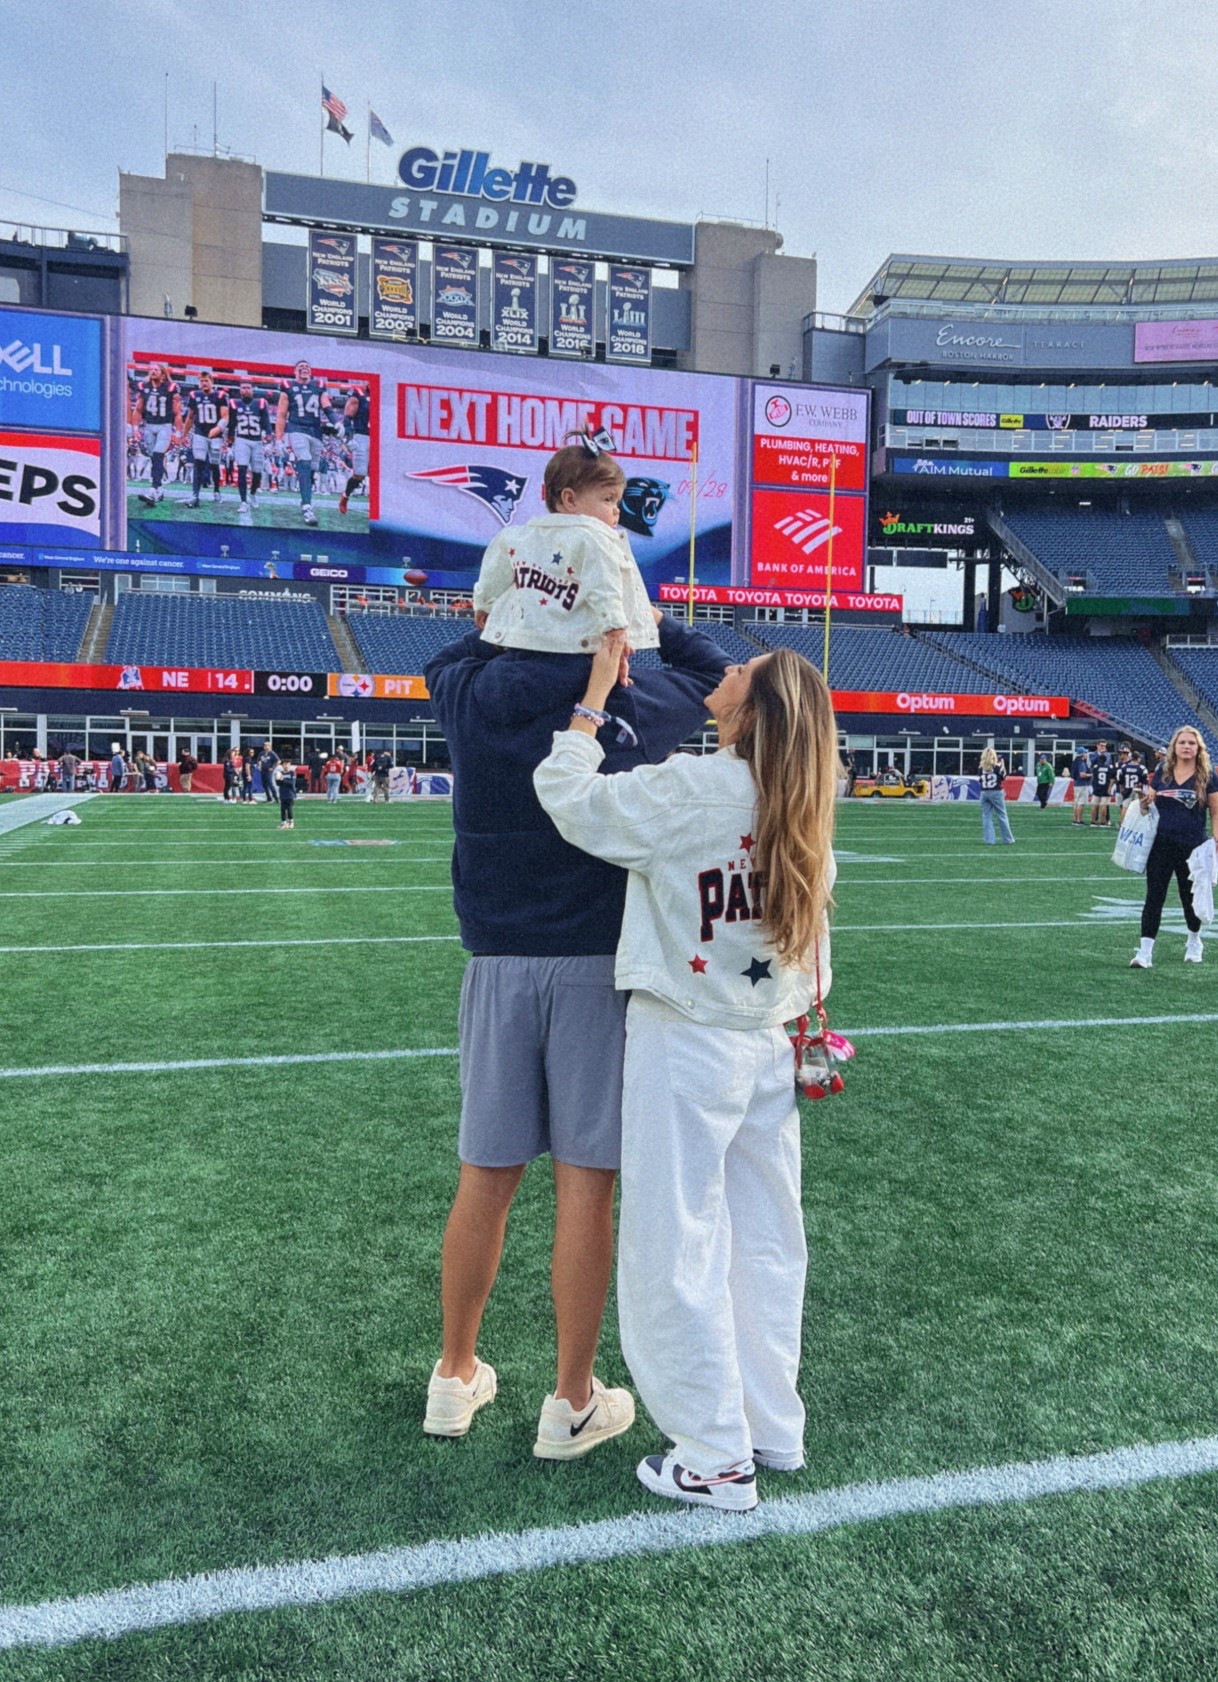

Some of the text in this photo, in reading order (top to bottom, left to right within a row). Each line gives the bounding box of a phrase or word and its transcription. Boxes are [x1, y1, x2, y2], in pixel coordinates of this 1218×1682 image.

[398, 146, 577, 210] Gillette
[388, 197, 588, 241] STADIUM
[318, 258, 349, 267] PATRIOTS
[328, 253, 354, 261] ENGLAND
[379, 265, 411, 274] PATRIOTS
[390, 260, 416, 268] ENGLAND
[441, 271, 471, 281] PATRIOTS
[450, 267, 475, 275] ENGLAND
[500, 279, 530, 288] PATRIOTS
[510, 274, 534, 282] ENGLAND
[559, 285, 587, 294] PATRIOTS
[568, 280, 592, 288] ENGLAND
[616, 292, 644, 300] PATRIOTS
[625, 287, 648, 295] ENGLAND
[319, 299, 346, 307] WORLD
[312, 305, 353, 316] CHAMPIONS
[382, 305, 408, 314] WORLD
[501, 309, 529, 319] XLIX
[314, 312, 351, 326] 2001
[374, 311, 414, 321] CHAMPIONS
[443, 311, 468, 320] WORLD
[436, 318, 475, 328] CHAMPIONS
[502, 318, 527, 327] WORLD
[561, 324, 585, 332] WORLD
[436, 325, 474, 338] 2004
[496, 325, 533, 335] CHAMPIONS
[554, 330, 591, 340] CHAMPIONS
[617, 329, 641, 337] WORLD
[498, 332, 532, 345] 2014
[611, 336, 647, 345] CHAMPIONS
[936, 324, 1021, 348] Encore
[613, 343, 645, 354] 2018
[1033, 341, 1086, 349] TERRACE
[0, 339, 72, 376] ELL
[942, 351, 1014, 362] BOSTON HARBOR
[146, 395, 166, 417] 41
[294, 394, 319, 418] 14
[197, 403, 217, 424] 10
[796, 404, 817, 417] F.W.
[820, 406, 858, 420] WEBB
[404, 386, 694, 460] NEXT HOME GAME
[809, 420, 843, 428] COMPANY
[906, 410, 997, 427] OUT OF TOWN SCORES
[1089, 415, 1148, 428] RAIDERS
[236, 414, 261, 435] 25
[760, 438, 860, 457] PLUMBING, HEATING,
[778, 454, 841, 469] HVAC/R, PF
[948, 466, 993, 476] Mutual
[1020, 466, 1048, 474] Gillette
[1125, 463, 1170, 476] GO PATS!
[791, 470, 828, 482] & more
[0, 459, 100, 520] EPS
[882, 522, 974, 535] DRAFTKINGS
[94, 556, 114, 564] We're
[130, 559, 157, 567] against
[310, 568, 348, 578] GEICO
[757, 562, 856, 576] BANK OF AMERICA
[239, 588, 311, 603] COMMONS
[661, 586, 900, 609] TOYOTA TOYOTA TOYOTA TOYOTA
[162, 672, 189, 687] NE
[214, 673, 238, 688] 14
[267, 674, 312, 692] 0:00
[384, 679, 413, 695] PIT
[896, 693, 1050, 715] Optum Optum
[981, 773, 998, 788] 12
[1098, 772, 1106, 785] 9
[1125, 774, 1139, 788] 12
